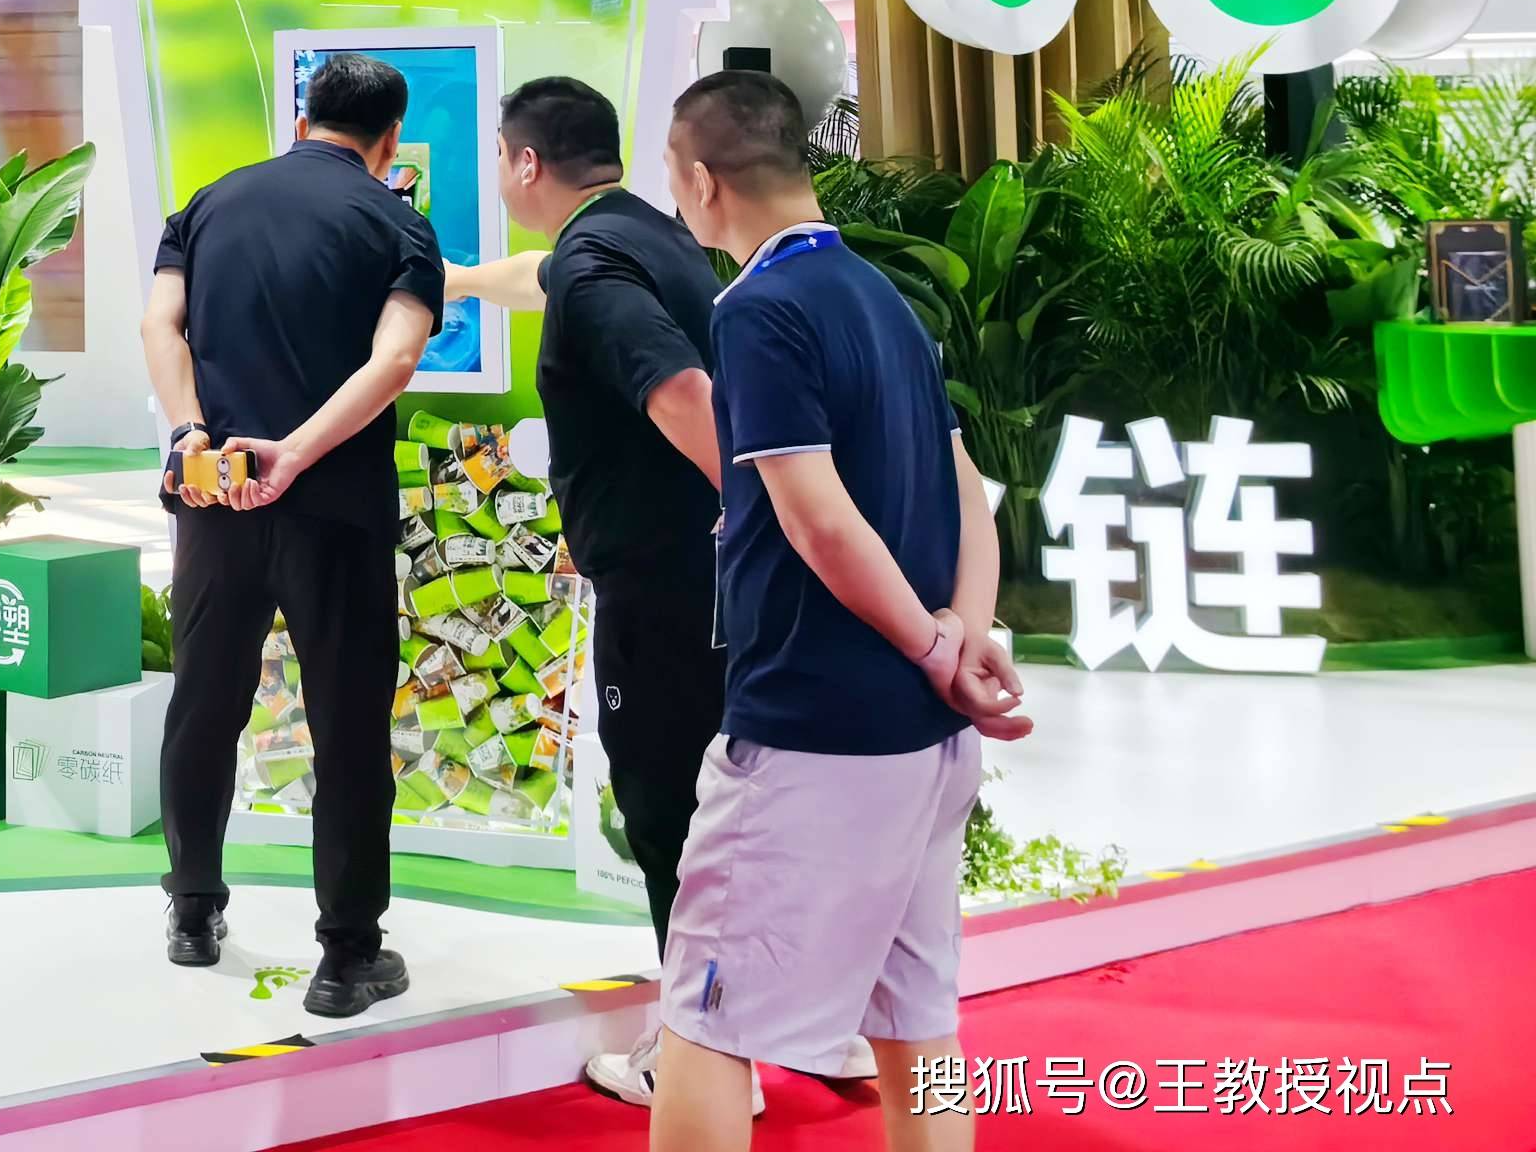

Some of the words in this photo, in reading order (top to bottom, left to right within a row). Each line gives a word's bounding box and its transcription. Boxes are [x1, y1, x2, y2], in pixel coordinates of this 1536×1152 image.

[969, 415, 1327, 674] 链
[72, 749, 97, 757] CARBON
[57, 756, 124, 785] 零碳纸
